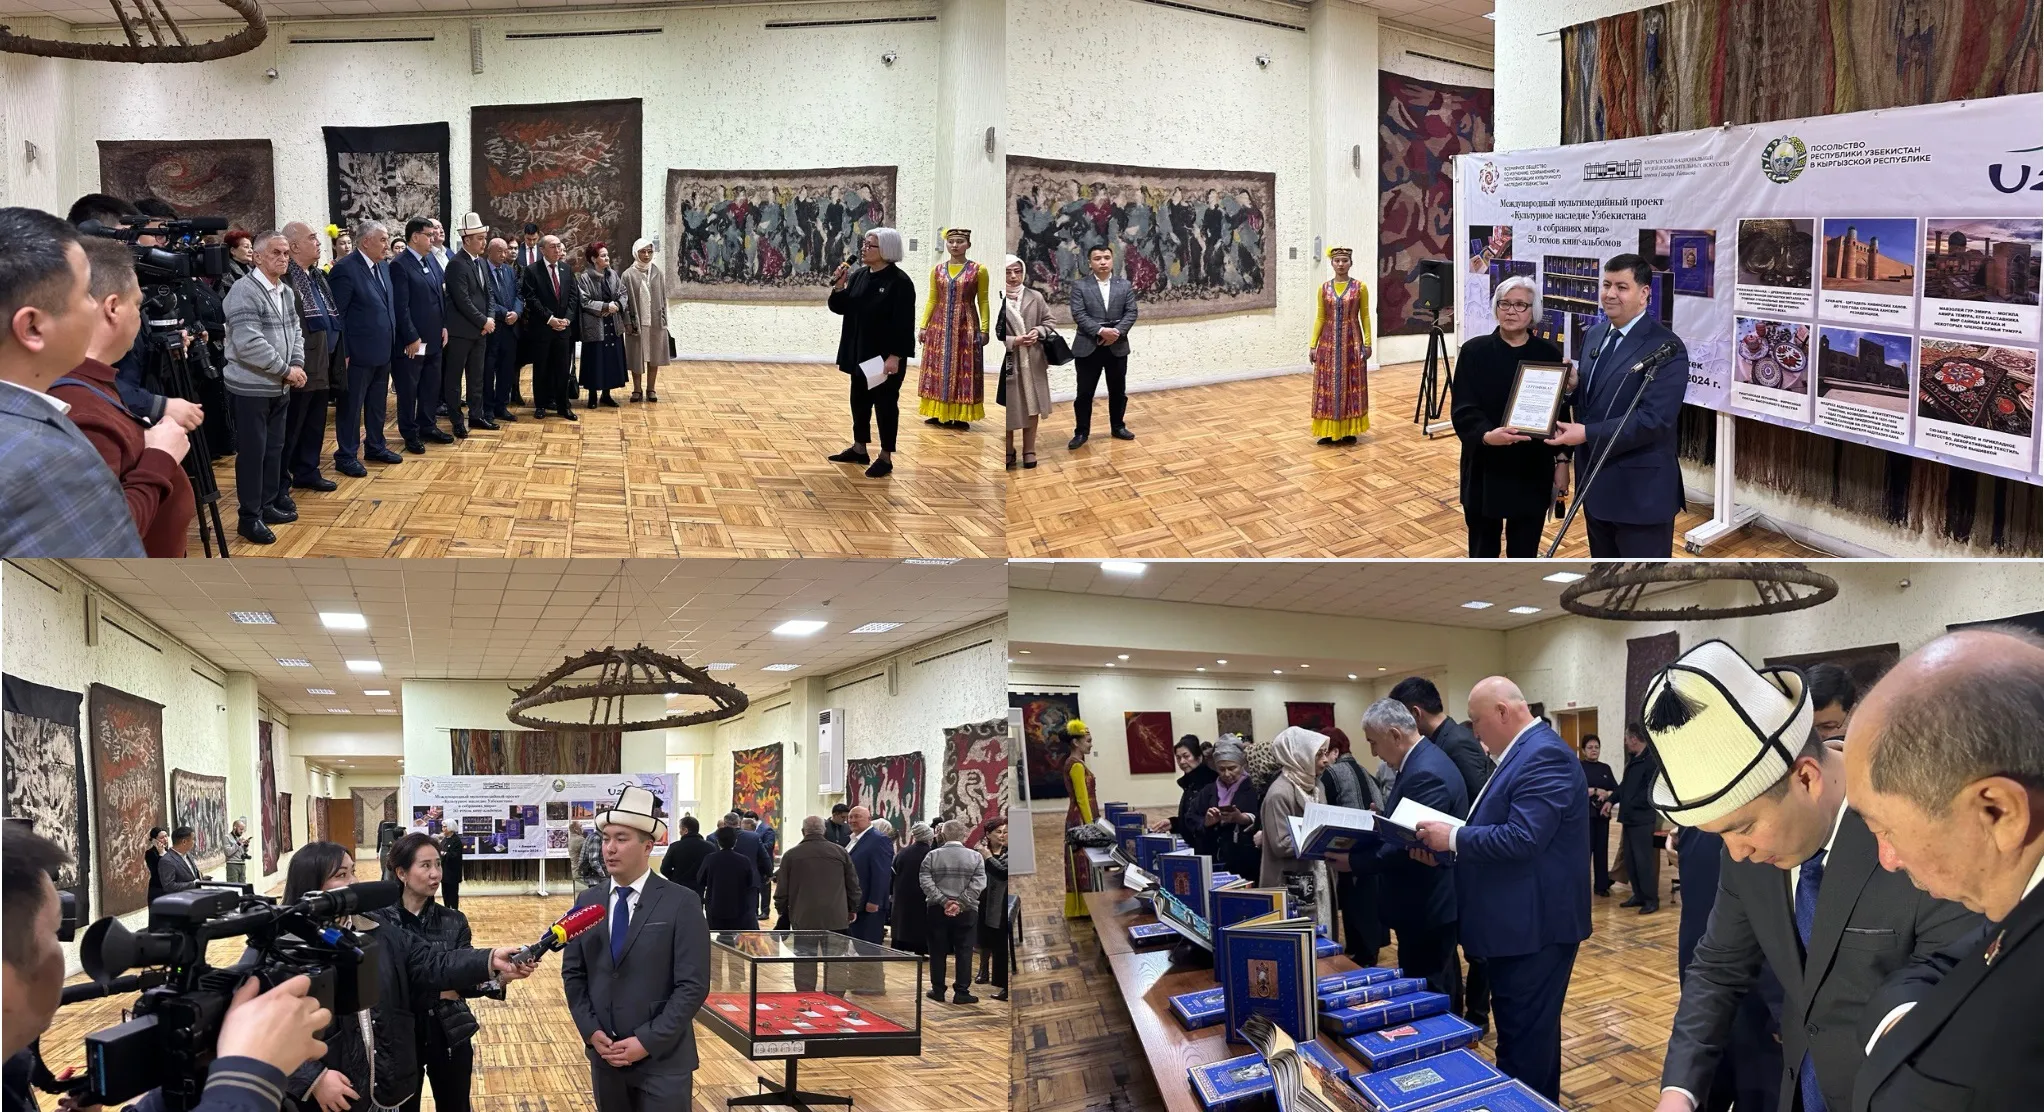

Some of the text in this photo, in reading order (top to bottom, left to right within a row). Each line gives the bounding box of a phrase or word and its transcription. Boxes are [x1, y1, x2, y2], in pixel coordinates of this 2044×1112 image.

[1810, 141, 1865, 151] ПОСОЛЬСТВО
[1810, 147, 1920, 160] РЕСПУБЛИКИ УЗБЕКИСТАН
[1817, 157, 1871, 168] КЫРГЫЗСКОЙ
[1873, 155, 1931, 165] РЕСПУБЛИКЕ
[1500, 197, 1664, 209] Международный мультимедийный проект
[1511, 210, 1646, 222] «Культурное наследие Узбекистана
[1543, 224, 1581, 234] собраниях
[1584, 225, 1609, 234] мира»
[1528, 235, 1536, 243] 50
[1562, 238, 1621, 248] книг-альбомов
